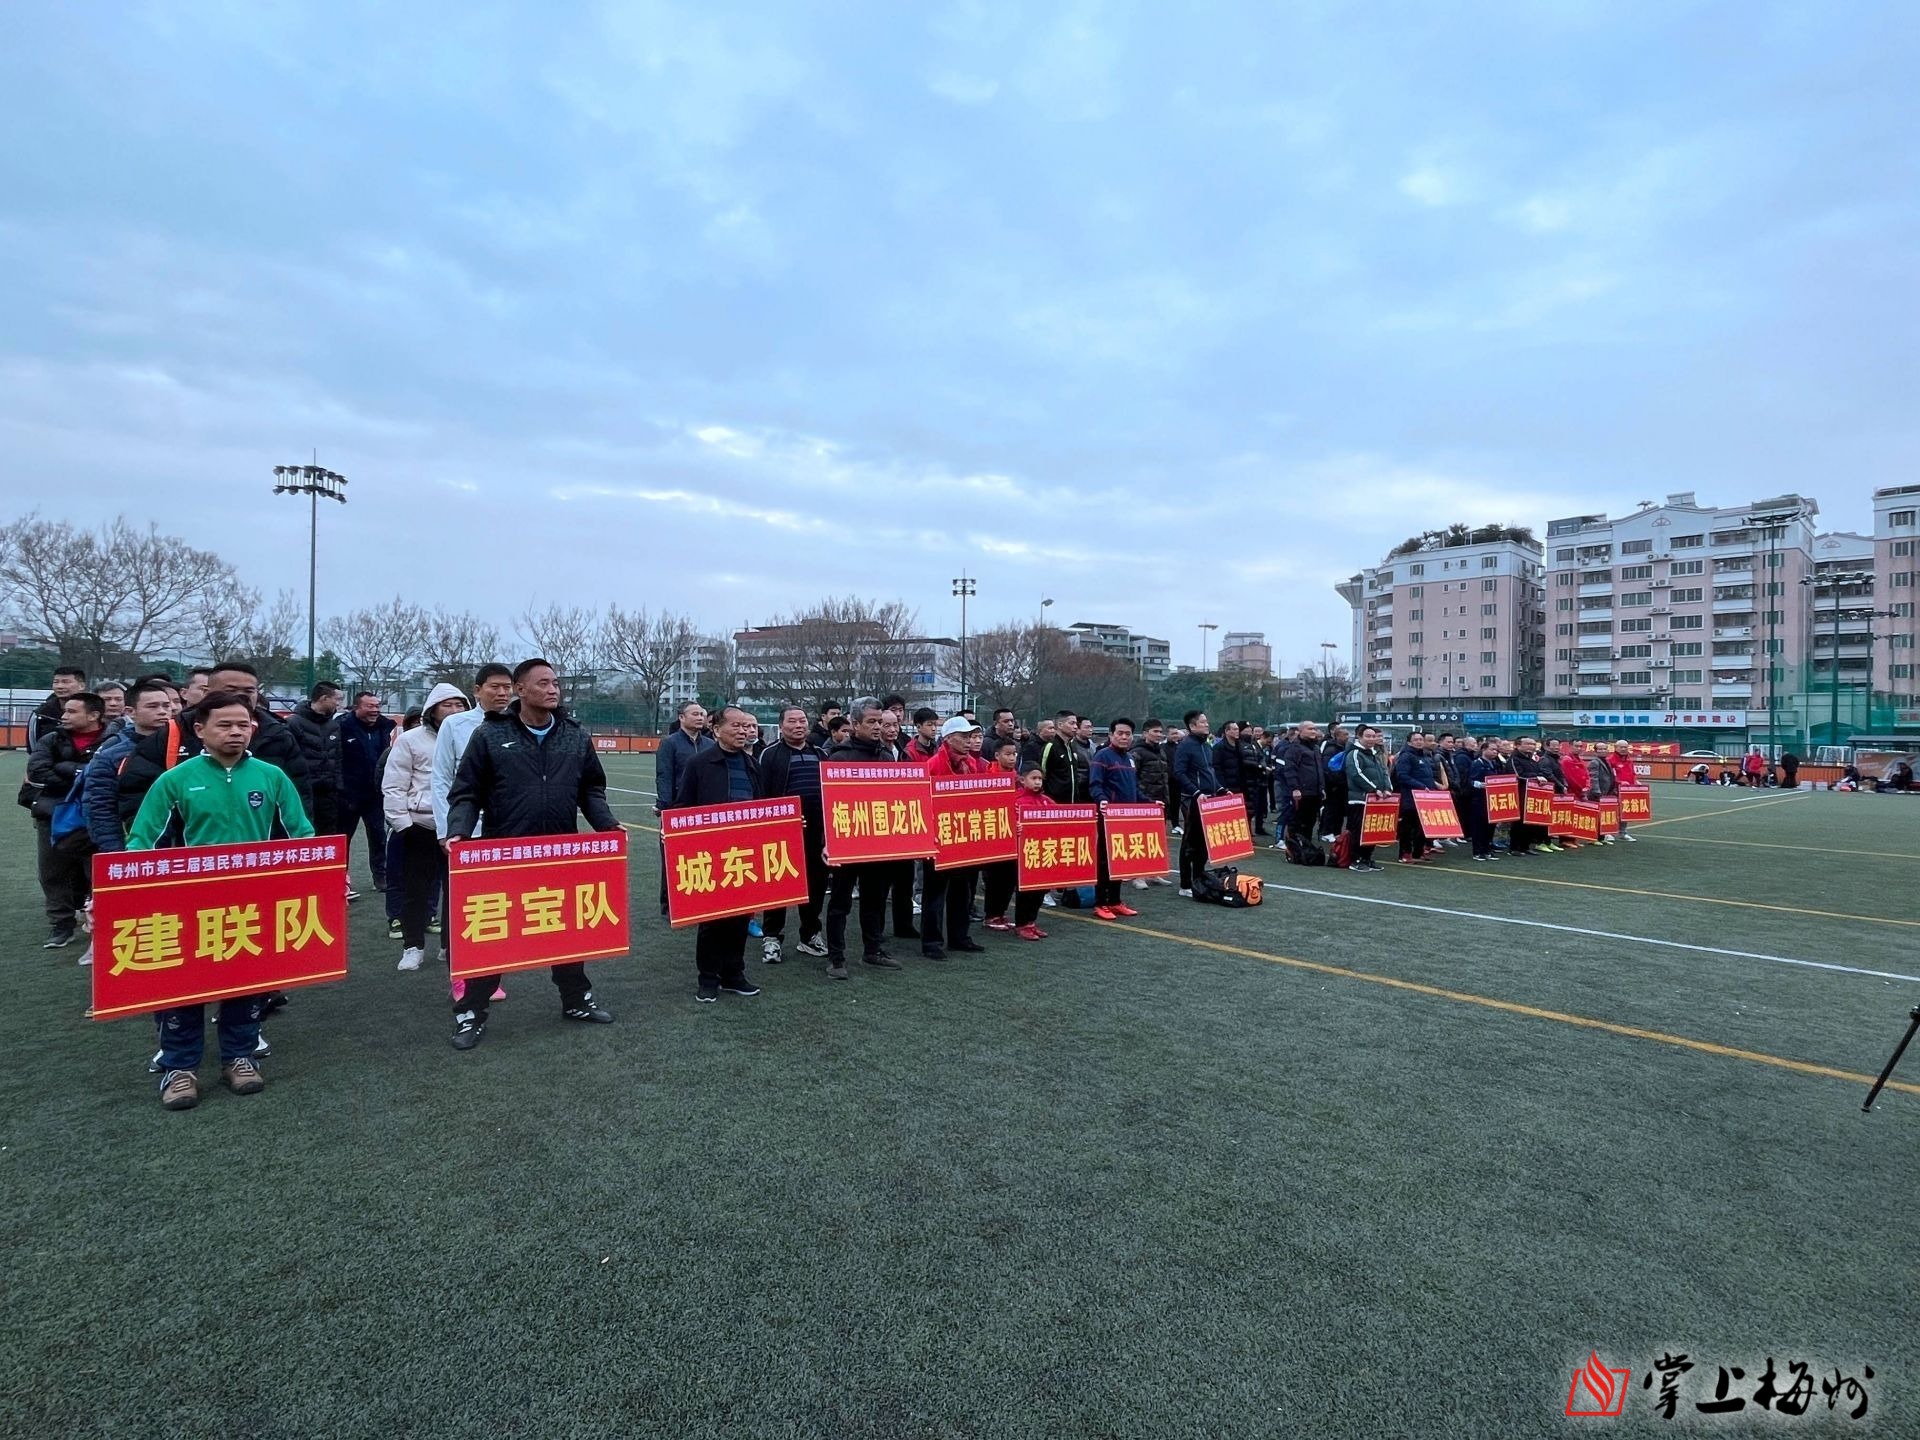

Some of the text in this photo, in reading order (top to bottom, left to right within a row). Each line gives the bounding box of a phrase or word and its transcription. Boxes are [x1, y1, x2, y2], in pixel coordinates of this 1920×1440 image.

[670, 804, 796, 829] 梅州市第三届强民常青贺岁杯足球赛
[832, 799, 928, 838] 梅州围龙队
[1489, 793, 1518, 812] 风云队
[938, 806, 1013, 846] 程江常青队
[108, 844, 336, 881] 梅州市第三届强民常青贺岁杯足球赛
[460, 839, 619, 864] 梅州市第三届强民常青贺岁杯足球赛
[1023, 836, 1094, 869] 饶家军队
[1110, 831, 1165, 861] 风采队
[676, 841, 800, 896] 城东队
[461, 881, 620, 943] 君宝队
[109, 895, 335, 977] 建联队
